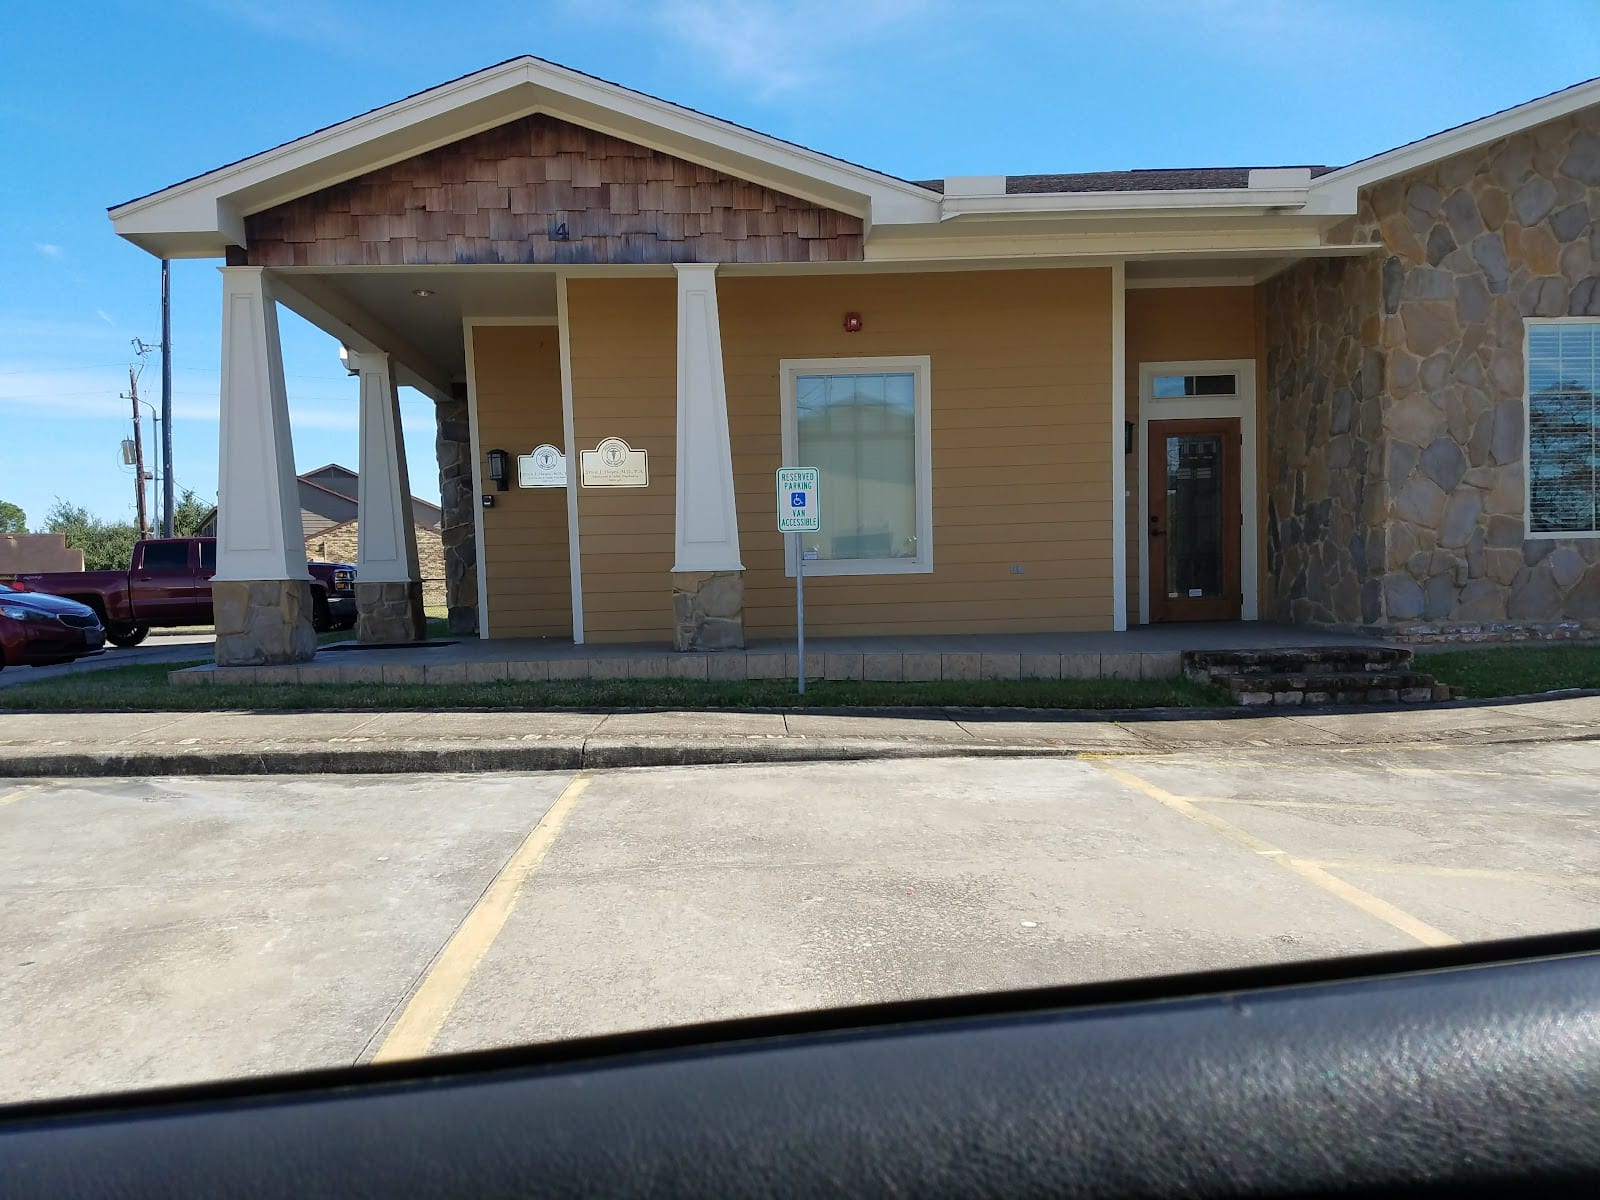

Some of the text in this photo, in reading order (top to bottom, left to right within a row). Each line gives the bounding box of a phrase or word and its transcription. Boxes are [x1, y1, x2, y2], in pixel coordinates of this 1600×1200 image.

[556, 222, 569, 239] 4
[781, 473, 814, 481] RESERVED
[784, 482, 812, 490] PARKING
[781, 518, 817, 526] ACCESSIBLE
